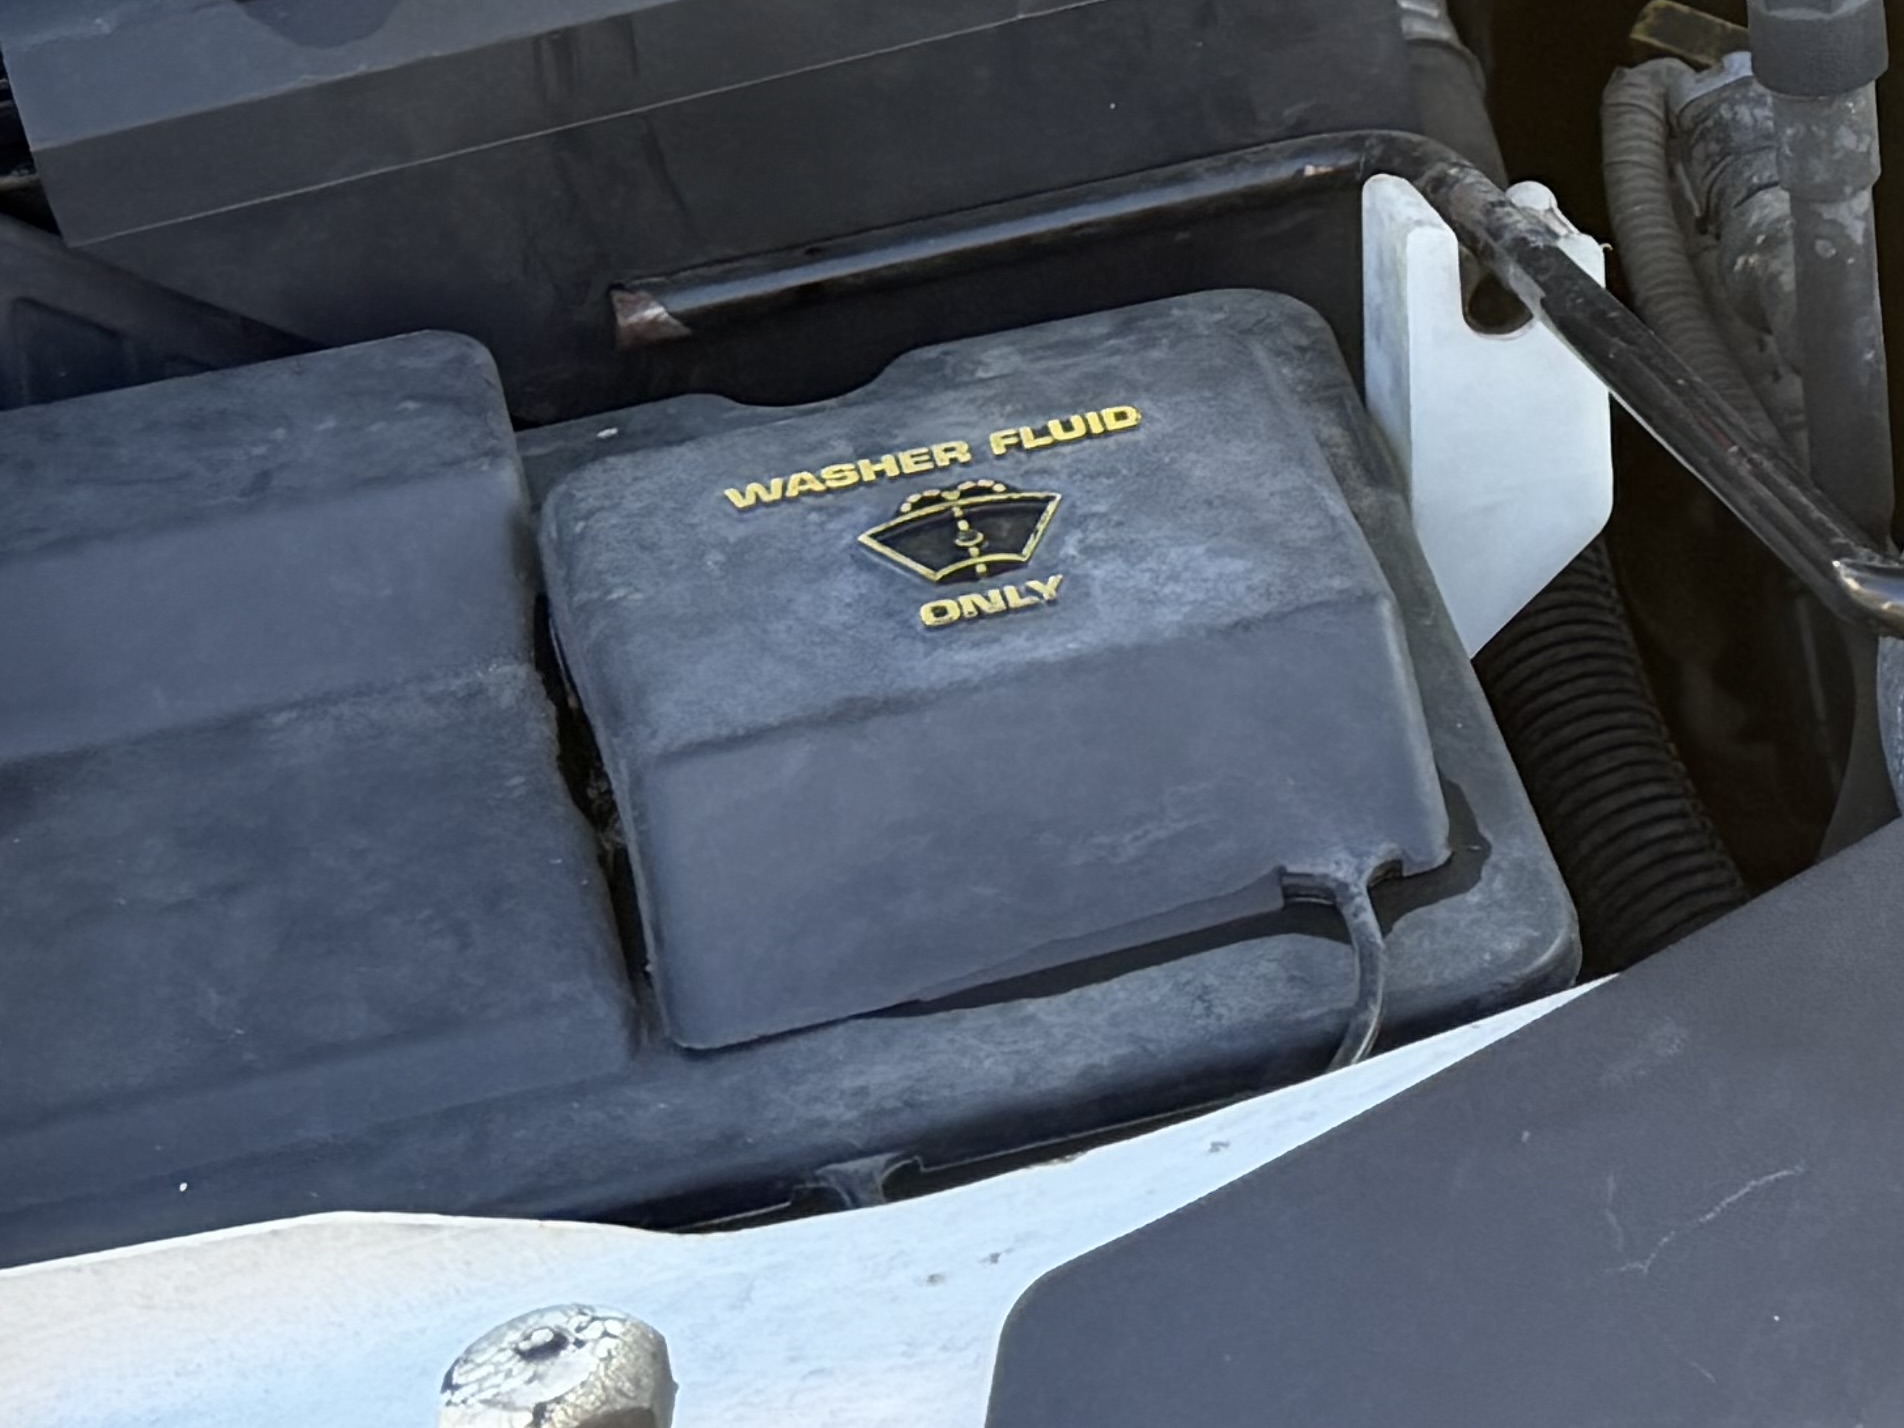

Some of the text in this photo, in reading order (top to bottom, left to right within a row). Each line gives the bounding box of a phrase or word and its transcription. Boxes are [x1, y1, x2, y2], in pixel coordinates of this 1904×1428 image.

[723, 405, 1143, 511] WASHER FLUID
[919, 575, 1064, 627] ONLY
